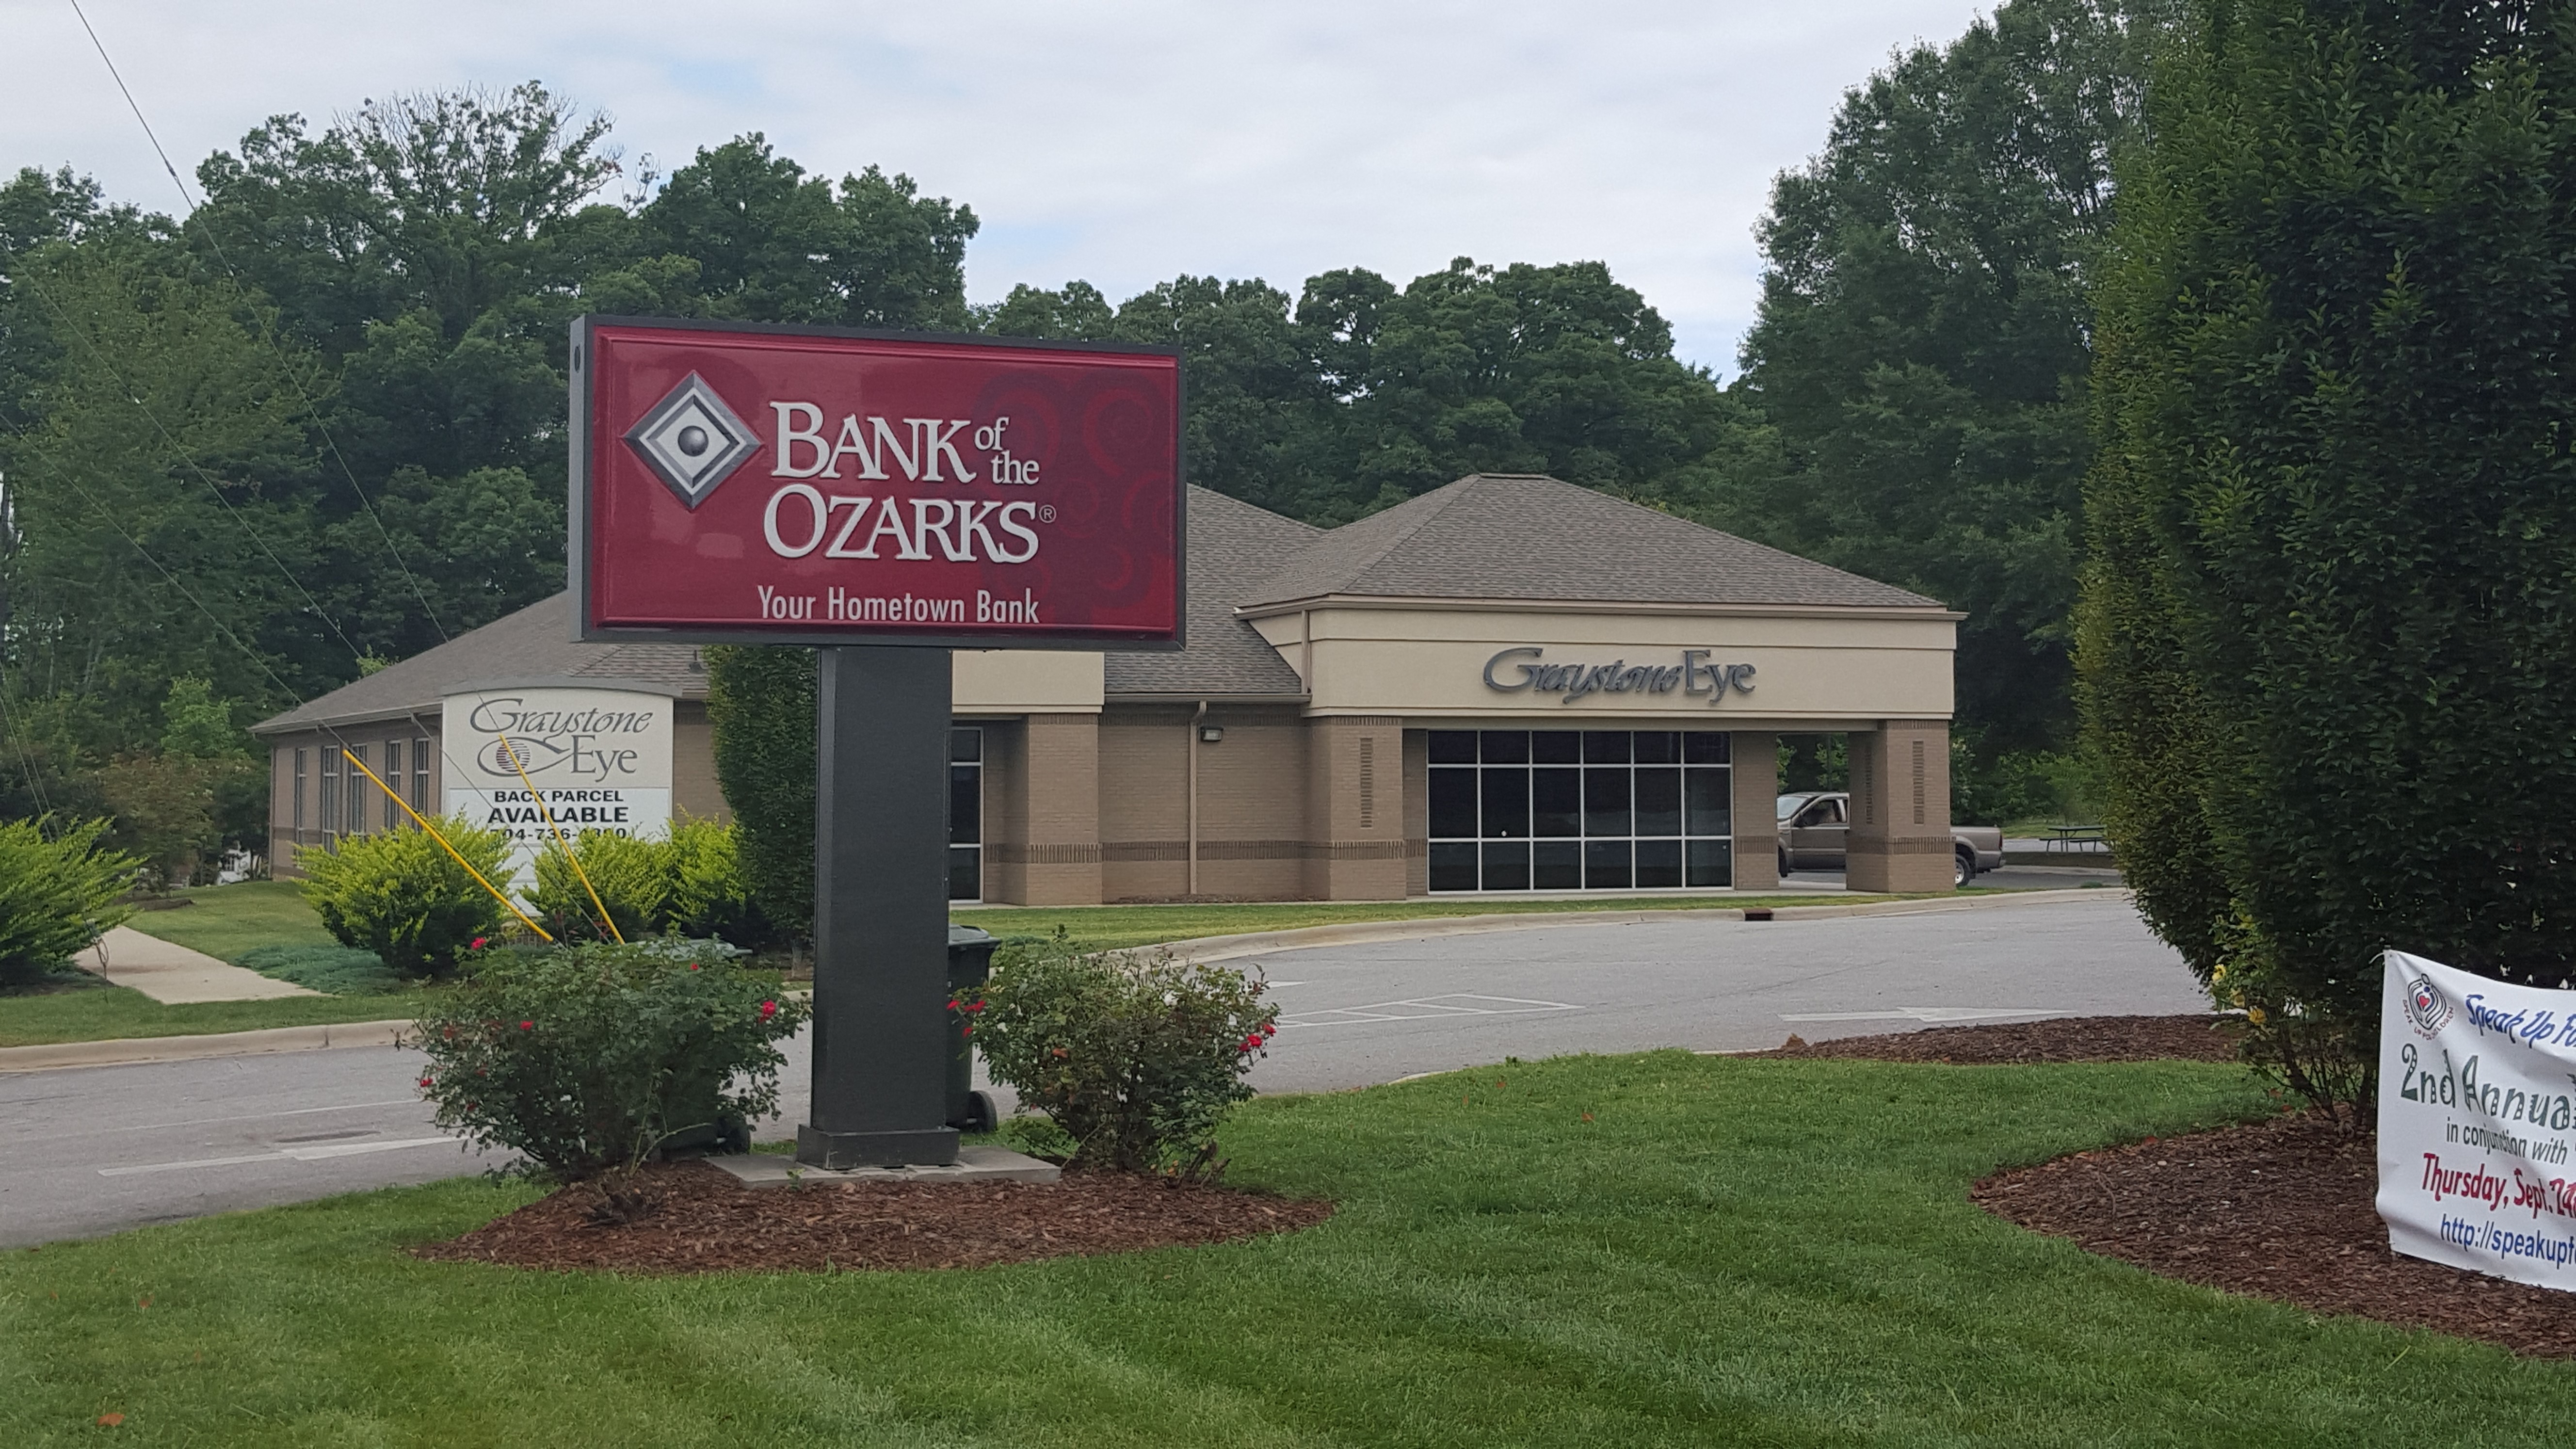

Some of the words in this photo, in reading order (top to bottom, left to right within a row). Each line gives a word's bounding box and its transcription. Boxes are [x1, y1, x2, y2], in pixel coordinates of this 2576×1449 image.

[770, 401, 976, 483] BANK
[975, 417, 1009, 451] of
[991, 451, 1040, 484] the
[757, 585, 817, 620] Your
[828, 587, 965, 623] Hometown
[977, 588, 1040, 624] Bank
[1483, 647, 1684, 705] Graystone
[1683, 649, 1756, 706] Eye
[469, 698, 653, 745] Graystone
[570, 735, 638, 783] Eye
[488, 807, 628, 823] AVAILABLE
[495, 790, 546, 802] BACK
[552, 790, 624, 802] PARCEL
[2466, 994, 2528, 1044] Speak
[2520, 1009, 2556, 1049] Up
[2401, 1043, 2456, 1109] 2nd
[2447, 1117, 2459, 1143] in
[2463, 1125, 2528, 1159] conjunction
[2532, 1137, 2568, 1166] with
[2422, 1153, 2509, 1211] Thursday,
[2513, 1168, 2553, 1219] Sept.
[2441, 1213, 2576, 1270] http://speakupf
